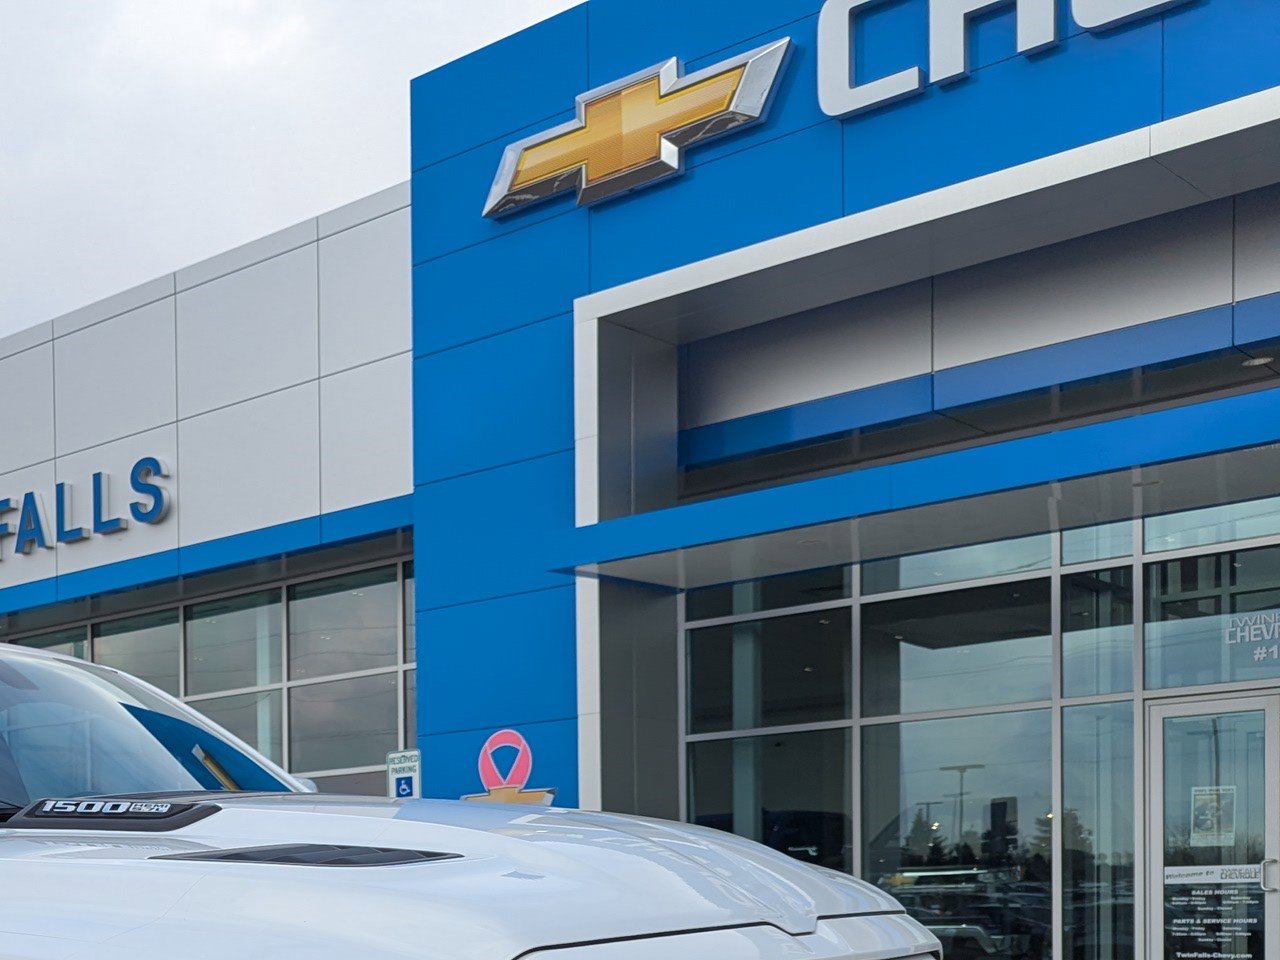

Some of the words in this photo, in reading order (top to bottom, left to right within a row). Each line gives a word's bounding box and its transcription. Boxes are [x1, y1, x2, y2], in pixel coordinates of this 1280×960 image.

[389, 754, 418, 765] RESERVED
[391, 765, 417, 775] PARKING
[42, 800, 132, 814] 1500
